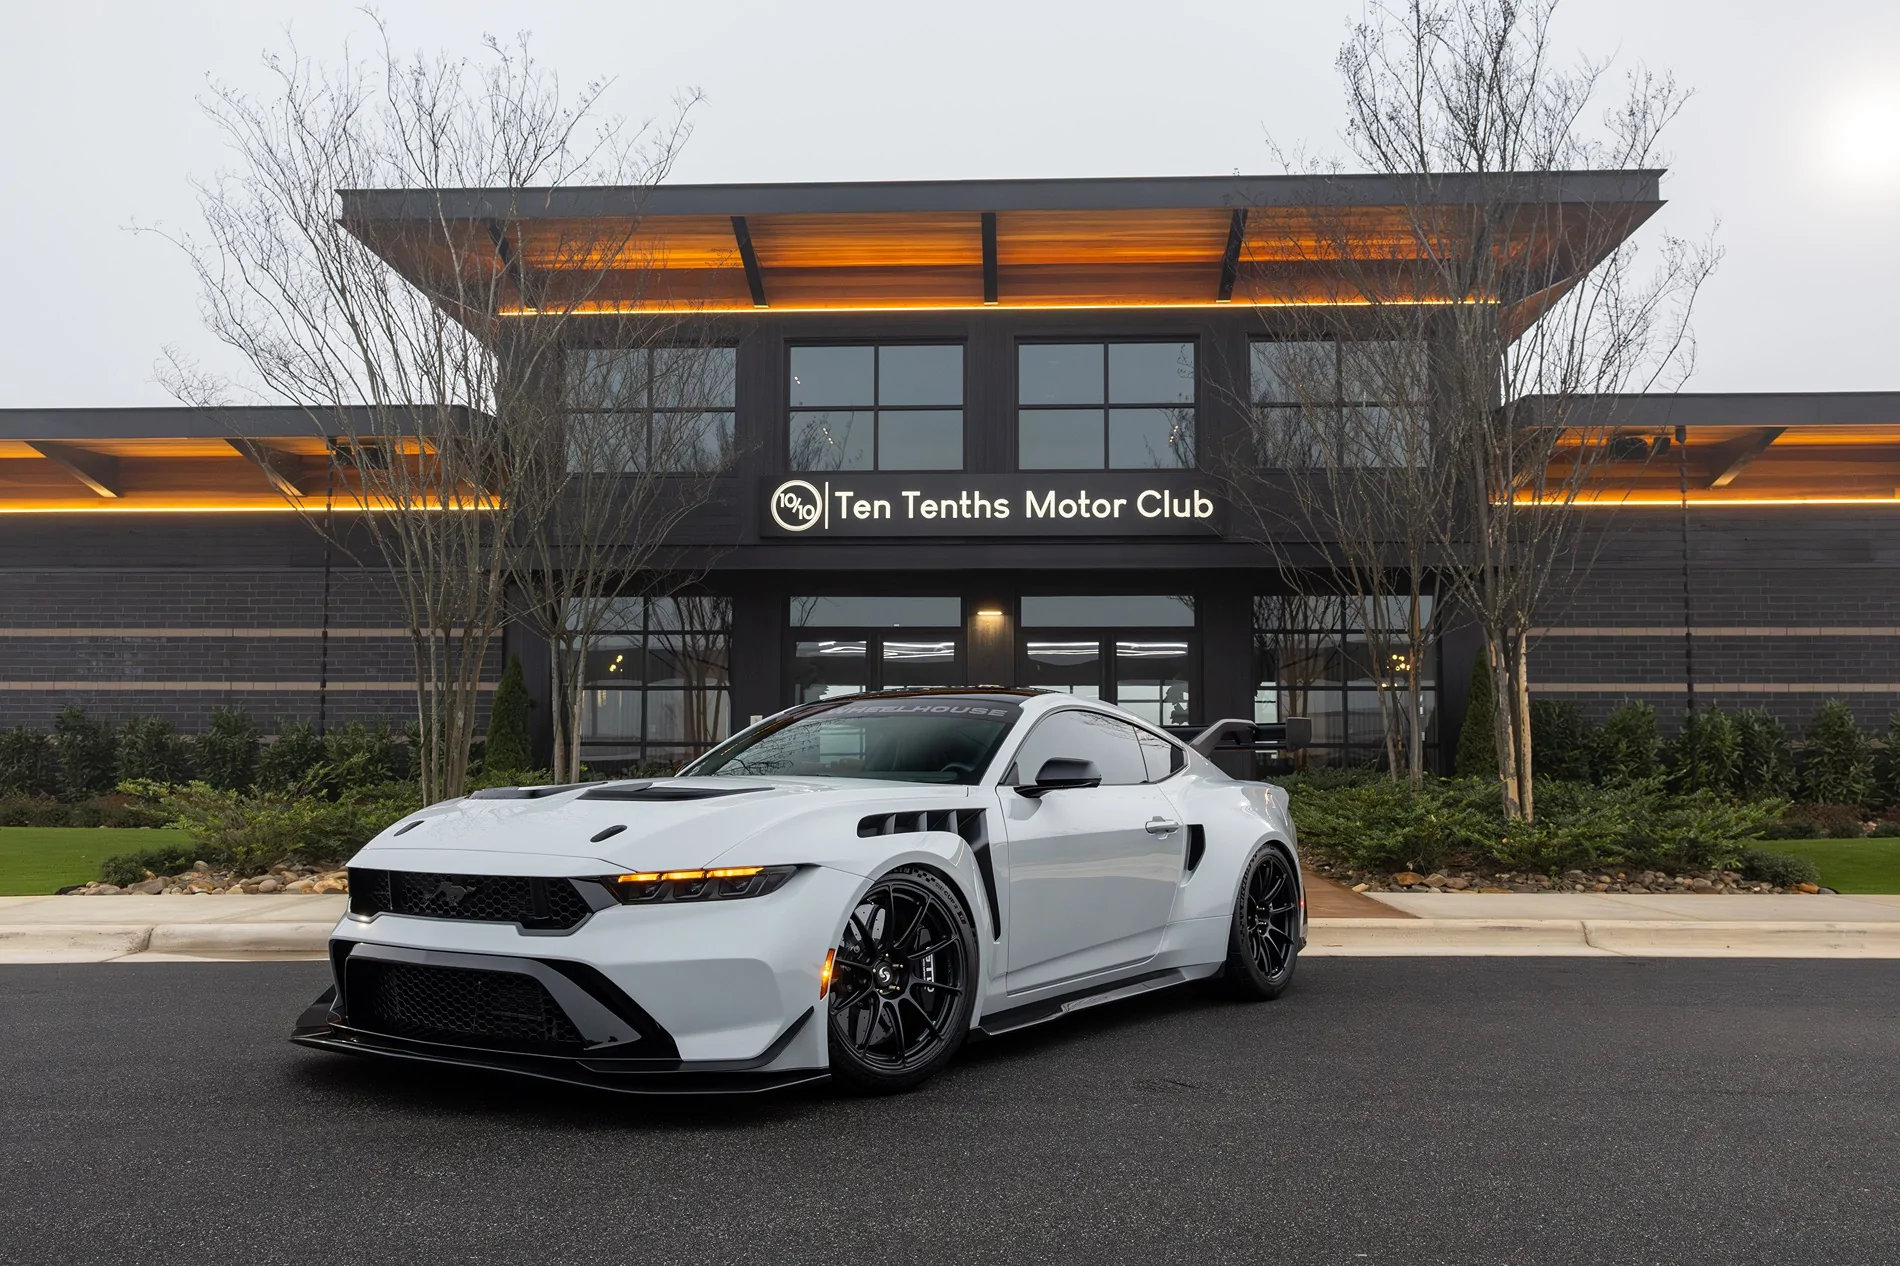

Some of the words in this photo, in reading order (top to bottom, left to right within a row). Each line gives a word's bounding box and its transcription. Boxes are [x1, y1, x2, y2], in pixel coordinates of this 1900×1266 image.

[835, 491, 891, 519] Ten
[902, 490, 1010, 519] Tenths
[1025, 489, 1127, 519] Motor
[1136, 489, 1214, 518] Club
[827, 705, 1008, 717] WHEELHOUSE
